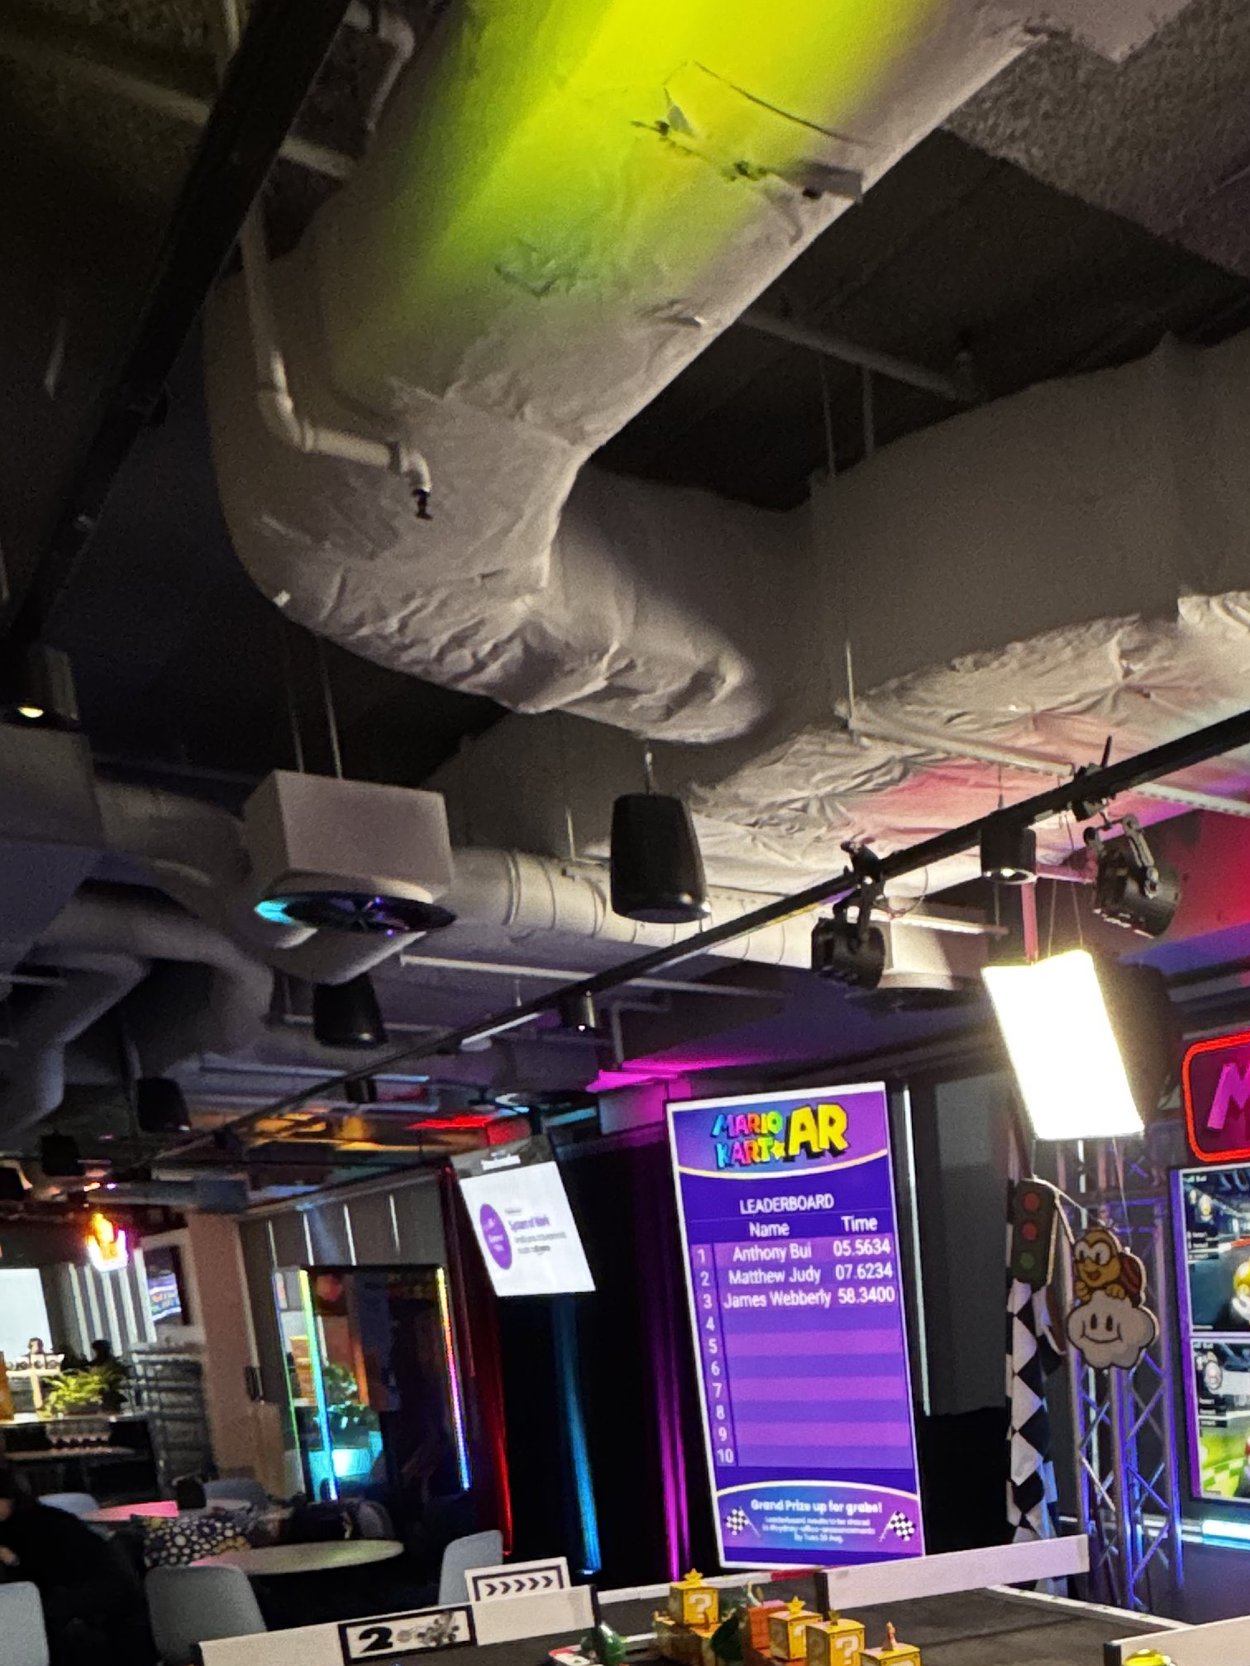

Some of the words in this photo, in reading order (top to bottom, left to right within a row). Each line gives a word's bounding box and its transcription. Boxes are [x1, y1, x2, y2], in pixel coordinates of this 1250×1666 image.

[711, 1110, 784, 1137] MARIO
[716, 1136, 774, 1168] KART
[787, 1103, 849, 1157] AR
[739, 1193, 835, 1215] LEADERBOARD
[749, 1221, 790, 1238] Name
[840, 1215, 878, 1232] Time
[697, 1248, 706, 1262] 1
[732, 1244, 787, 1263] Anthony
[789, 1242, 812, 1259] Bui
[832, 1238, 891, 1257] 05.5634
[700, 1271, 709, 1286] 2
[728, 1268, 786, 1285] Matthew
[789, 1265, 821, 1286] Judy
[835, 1261, 893, 1281] 07.6234
[703, 1293, 712, 1309] 3
[723, 1292, 767, 1310] James
[769, 1288, 832, 1309] Webberly
[837, 1286, 895, 1305] 58.3400
[705, 1316, 715, 1331] 4
[708, 1338, 718, 1354] 5
[711, 1360, 720, 1376] 6
[712, 1382, 723, 1398] 7
[716, 1404, 725, 1420] 8
[718, 1426, 727, 1441] 9
[716, 1448, 735, 1464] 10
[751, 1499, 785, 1511] Grand
[785, 1498, 811, 1511] Prize
[812, 1502, 827, 1515] up
[828, 1499, 844, 1512] for
[358, 1626, 394, 1654] 2
